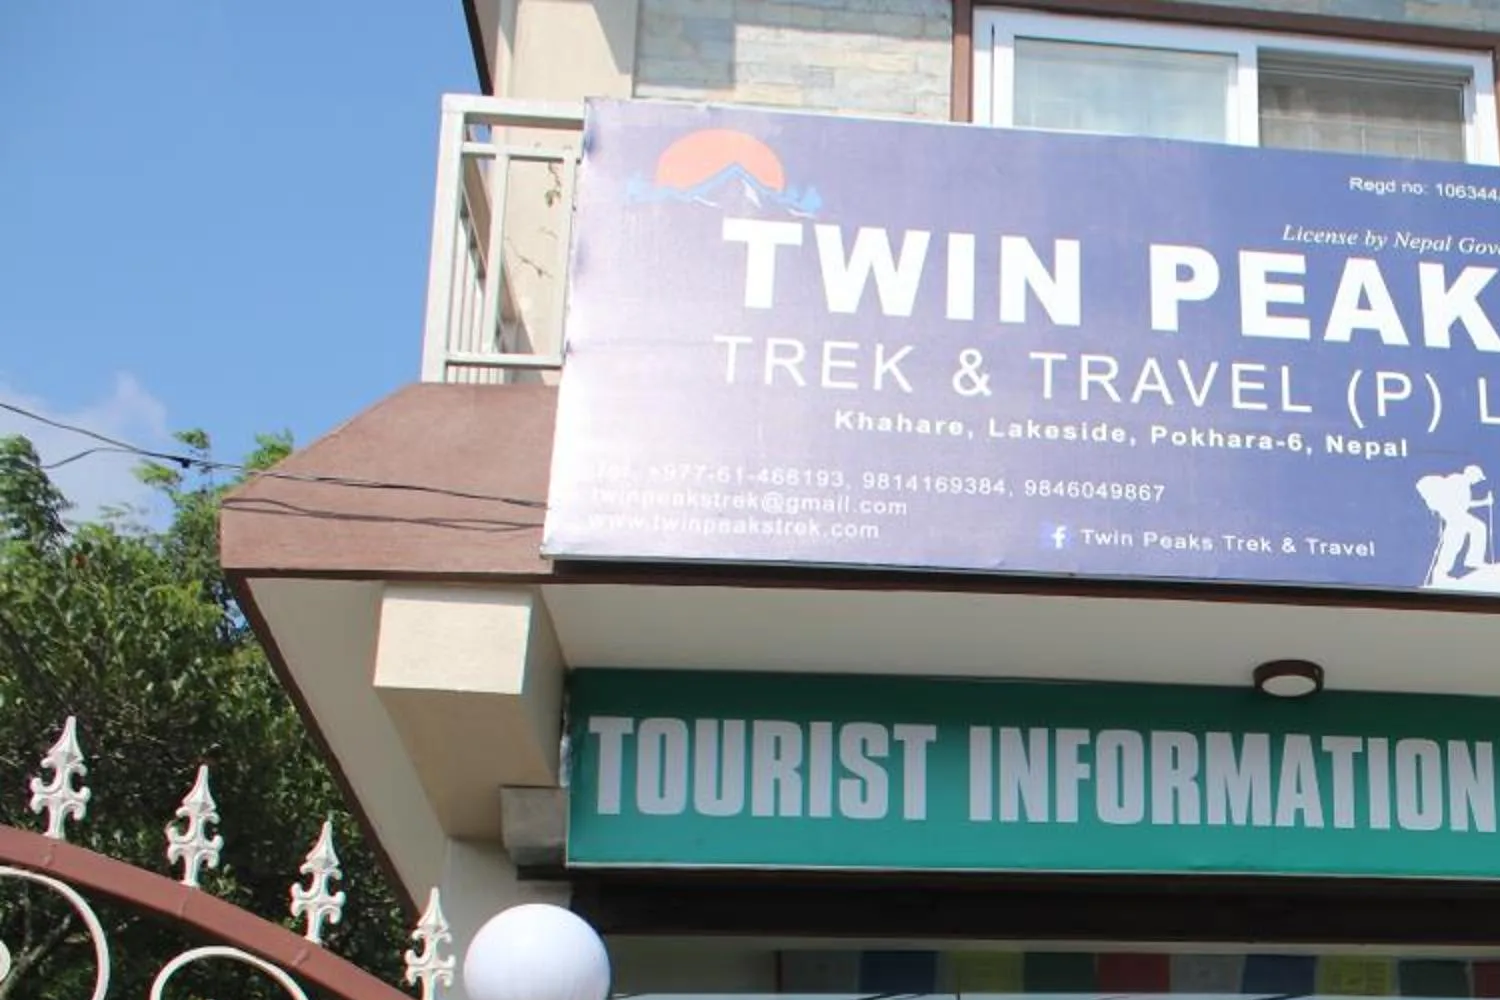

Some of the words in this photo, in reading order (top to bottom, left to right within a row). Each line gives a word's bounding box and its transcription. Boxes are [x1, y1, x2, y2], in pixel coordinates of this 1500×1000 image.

[1350, 177, 1397, 196] Regd
[1402, 180, 1427, 196] no:
[1282, 224, 1357, 246] License
[1365, 229, 1388, 250] by
[1394, 231, 1452, 253] Nepal
[721, 216, 1081, 326] TWIN
[713, 333, 916, 393] TREK
[952, 348, 993, 397] &
[1029, 352, 1313, 415] TRAVEL
[1347, 369, 1443, 433] (P)
[834, 408, 974, 439] Khahare,
[988, 416, 1137, 446] Lakeside,
[1150, 425, 1313, 455] Pokhara-6,
[1325, 434, 1409, 461] Nepal
[1024, 479, 1166, 502] 9846049867
[1080, 528, 1134, 547] Twin
[1143, 530, 1214, 550] Peaks
[1222, 534, 1273, 553] Trek
[1281, 535, 1297, 553] &
[1304, 537, 1376, 557] Travel
[588, 715, 937, 821] TOURIST
[968, 725, 1497, 833] INFORMATION
